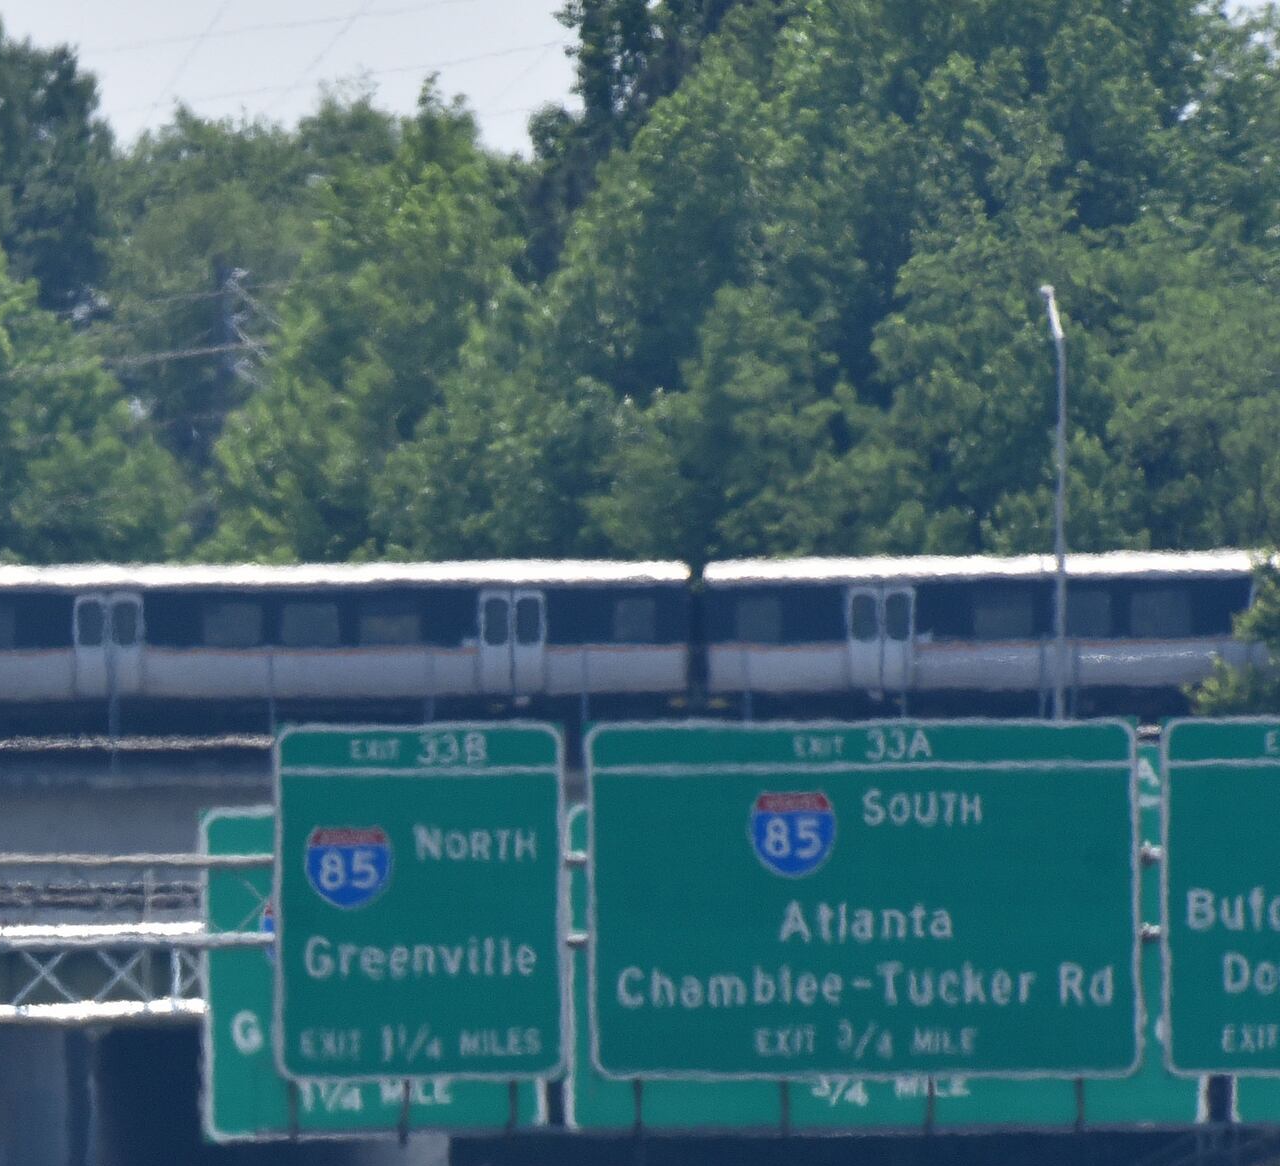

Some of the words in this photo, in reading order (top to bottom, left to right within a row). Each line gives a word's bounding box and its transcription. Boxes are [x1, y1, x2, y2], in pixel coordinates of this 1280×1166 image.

[350, 738, 400, 760] EXIT
[416, 732, 487, 767] 33B
[794, 732, 844, 757] EXIT
[866, 728, 932, 762] 33A
[863, 788, 982, 826] SOUTH
[413, 825, 536, 860] NORTH
[765, 818, 822, 858] 85
[320, 850, 379, 891] 85
[779, 901, 953, 942] Atlanta
[304, 935, 537, 980] Greenville
[1223, 952, 1280, 995] Do
[617, 961, 1035, 1008] Chamblee-Tucker
[1059, 962, 1114, 1005] Rd
[300, 1029, 361, 1058] EXIT
[459, 1028, 541, 1056] MILES
[755, 1024, 815, 1056] EXIT
[912, 1028, 976, 1054] MILE
